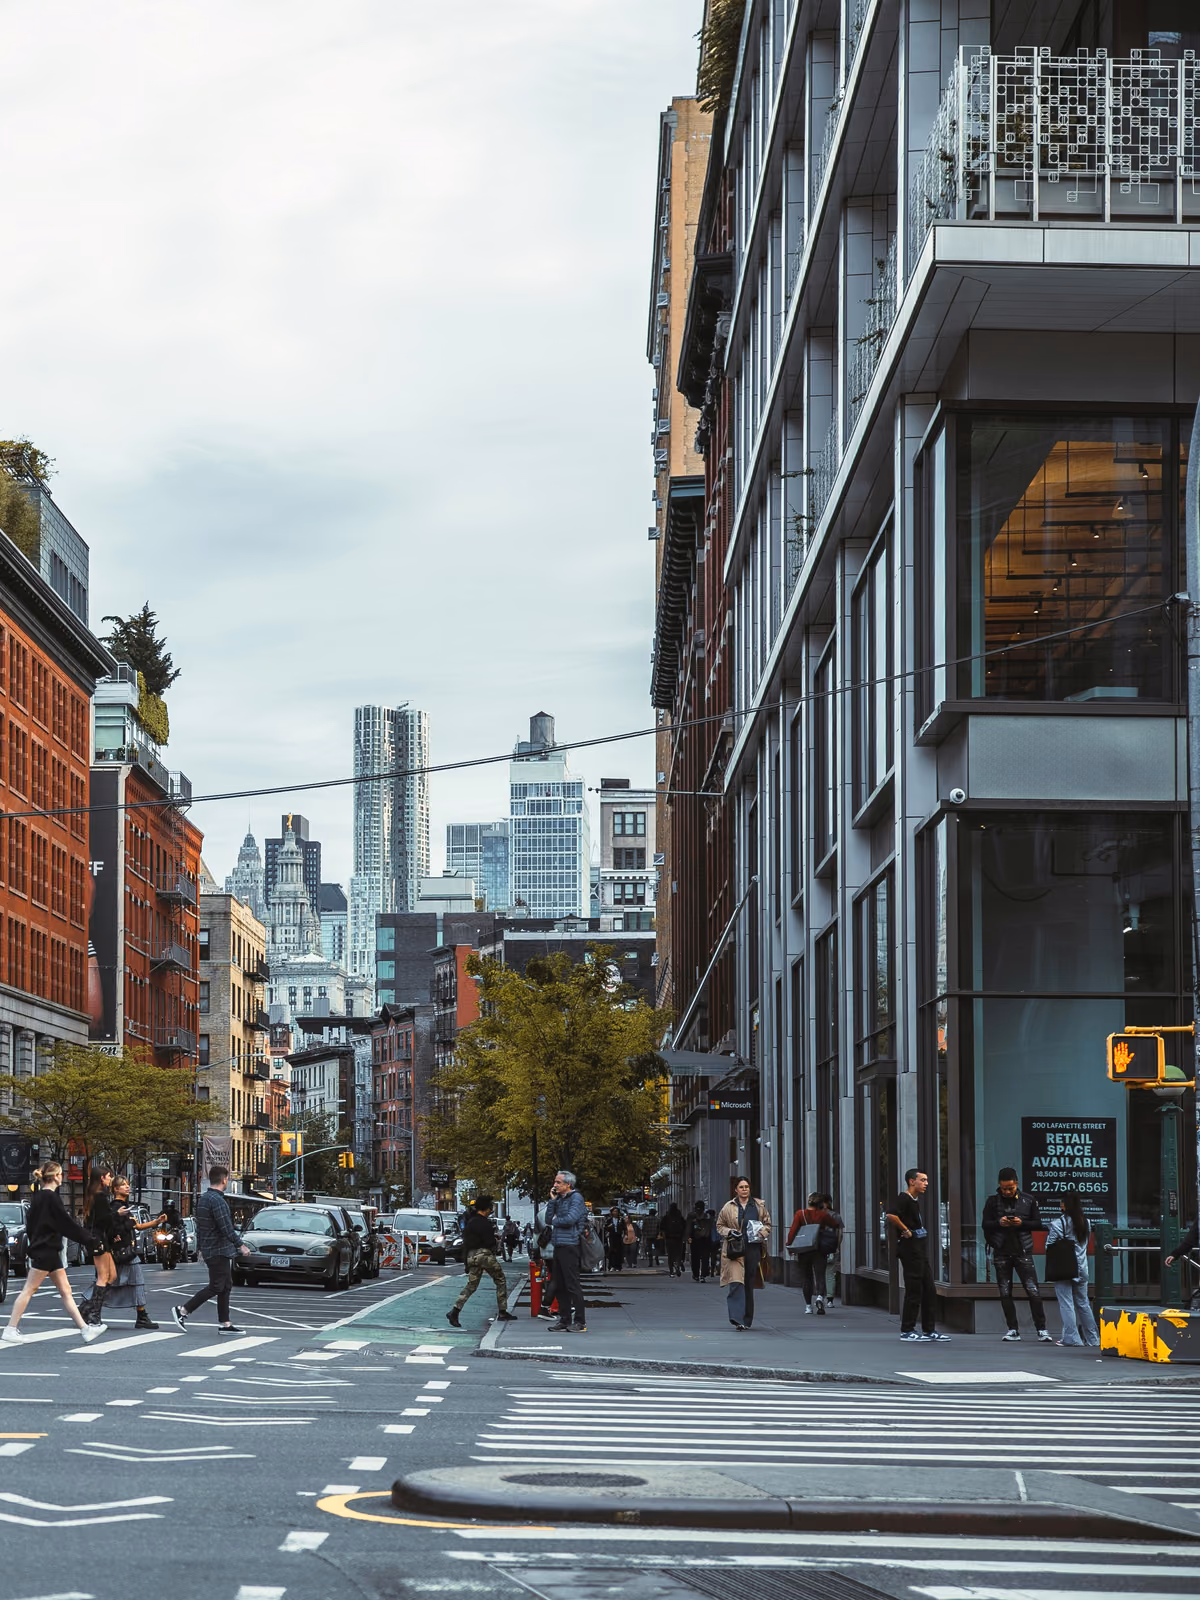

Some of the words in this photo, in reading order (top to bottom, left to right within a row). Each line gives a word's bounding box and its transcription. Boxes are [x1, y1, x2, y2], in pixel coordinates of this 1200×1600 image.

[88, 861, 104, 876] F
[721, 1101, 752, 1109] Microsoft
[1046, 1133, 1093, 1144] RETAIL
[1047, 1145, 1092, 1156] SPACE
[1032, 1157, 1108, 1168] AVAILABLE
[1031, 1182, 1109, 1192] 212.750.6565
